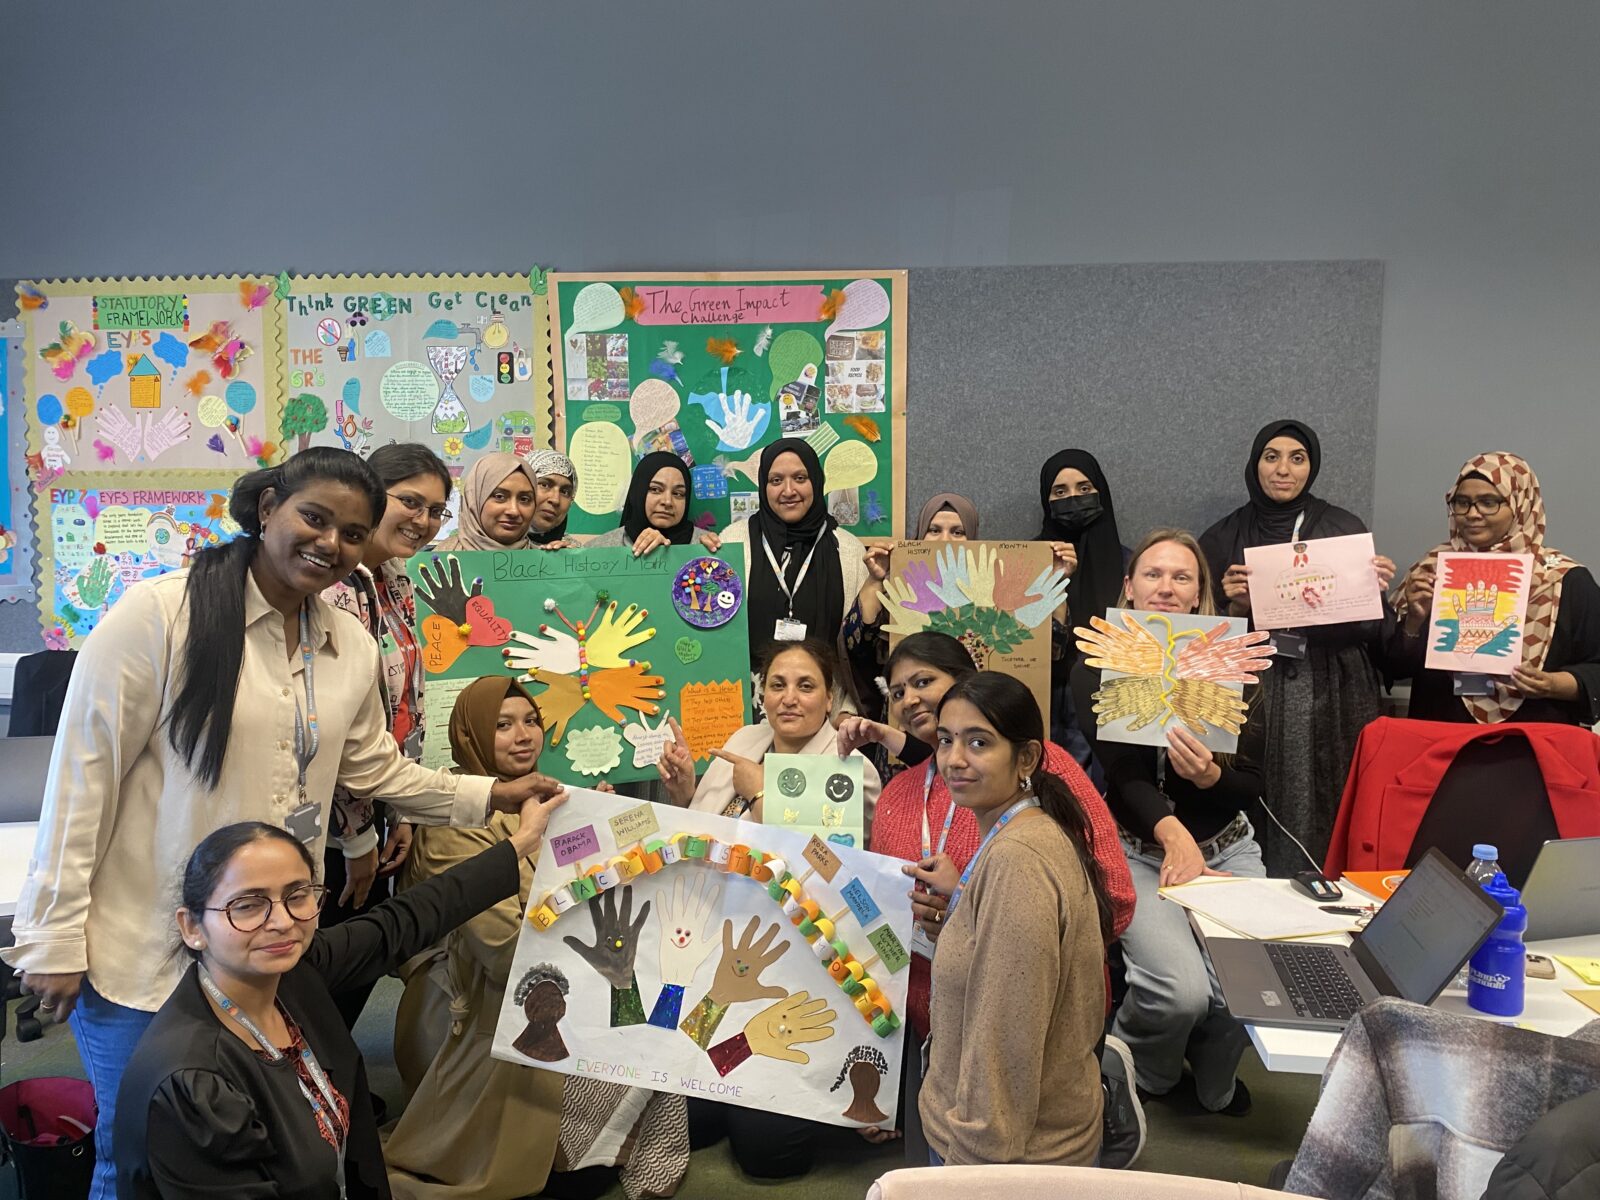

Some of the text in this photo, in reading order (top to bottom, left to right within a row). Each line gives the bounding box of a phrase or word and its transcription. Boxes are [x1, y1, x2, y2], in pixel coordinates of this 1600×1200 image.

[100, 295, 178, 312] STATUTORY
[286, 292, 412, 316] Think GREEN
[428, 291, 532, 312] Get Clean
[646, 290, 682, 314] The
[689, 288, 731, 312] Green
[735, 288, 790, 316] Impact
[106, 310, 184, 326] FRAMEWORK
[681, 311, 744, 324] Challenge
[290, 348, 323, 365] THE
[50, 488, 75, 504] EYP
[100, 490, 206, 505] EYFS FRAMEWORK
[999, 542, 1028, 550] MONTH
[493, 552, 556, 580] Black
[564, 555, 619, 575] History
[472, 600, 509, 641] EQUALITY
[429, 621, 443, 667] PEACE
[614, 810, 645, 826] SERENA
[616, 819, 651, 836] WILLIAMS
[554, 832, 586, 848] BARACK
[560, 840, 592, 857] OBAMA
[811, 838, 828, 855] ROSA
[811, 848, 829, 866] PARKS
[846, 890, 869, 918] MANDELA
[850, 883, 872, 913] NELSON
[876, 940, 891, 961] KING
[879, 933, 901, 962] LUTHER
[884, 928, 905, 956] MARTIN
[576, 1058, 743, 1097] EVERYONE IS WELCOME
